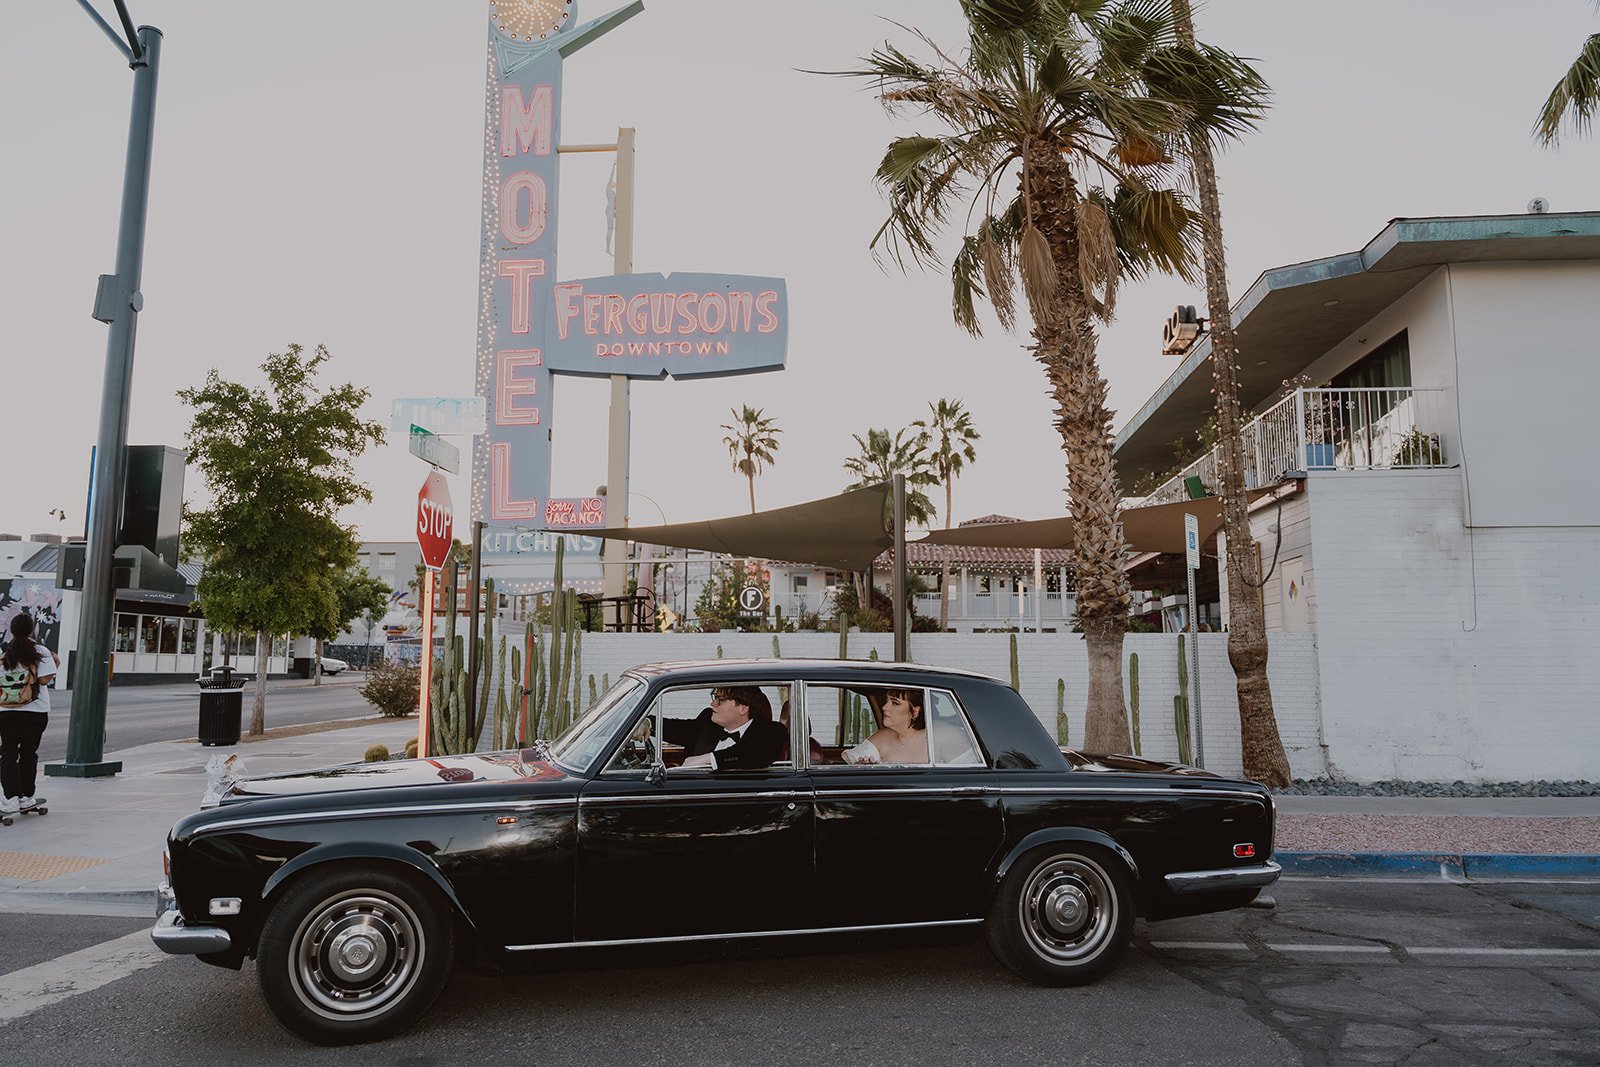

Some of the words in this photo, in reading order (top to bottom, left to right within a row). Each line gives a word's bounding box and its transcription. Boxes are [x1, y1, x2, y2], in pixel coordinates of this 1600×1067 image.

[491, 84, 553, 520] MOTEL
[596, 341, 729, 357] DOWNTOWN
[546, 498, 574, 514] Sorry
[581, 498, 603, 511] NO
[419, 498, 452, 540] STOP
[545, 511, 604, 525] VACANCY
